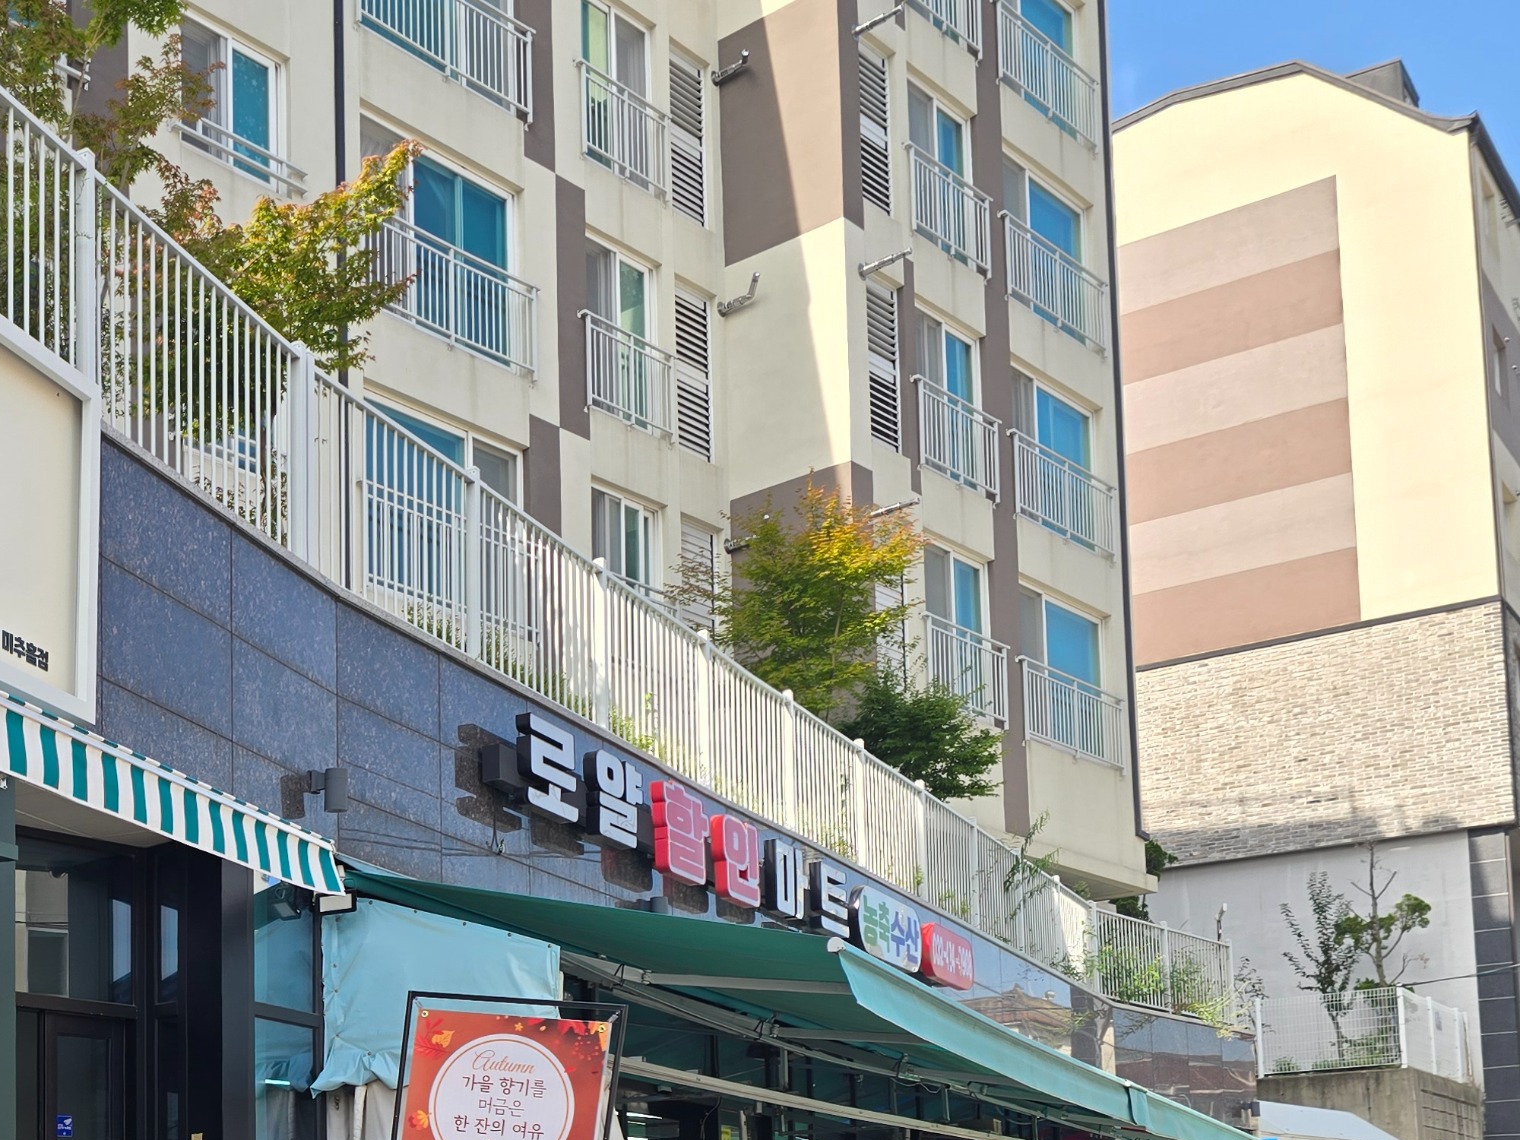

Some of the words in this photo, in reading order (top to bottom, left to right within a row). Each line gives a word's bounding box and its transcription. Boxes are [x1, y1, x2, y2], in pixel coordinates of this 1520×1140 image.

[863, 894, 920, 965] 농축수산
[472, 1050, 536, 1075] Autumn
[462, 1074, 494, 1093] 가을
[499, 1077, 547, 1099] 향기를
[478, 1097, 525, 1118] 머금은
[453, 1114, 470, 1132] 한
[474, 1118, 505, 1137] 잔의
[512, 1123, 545, 1140] 여유
